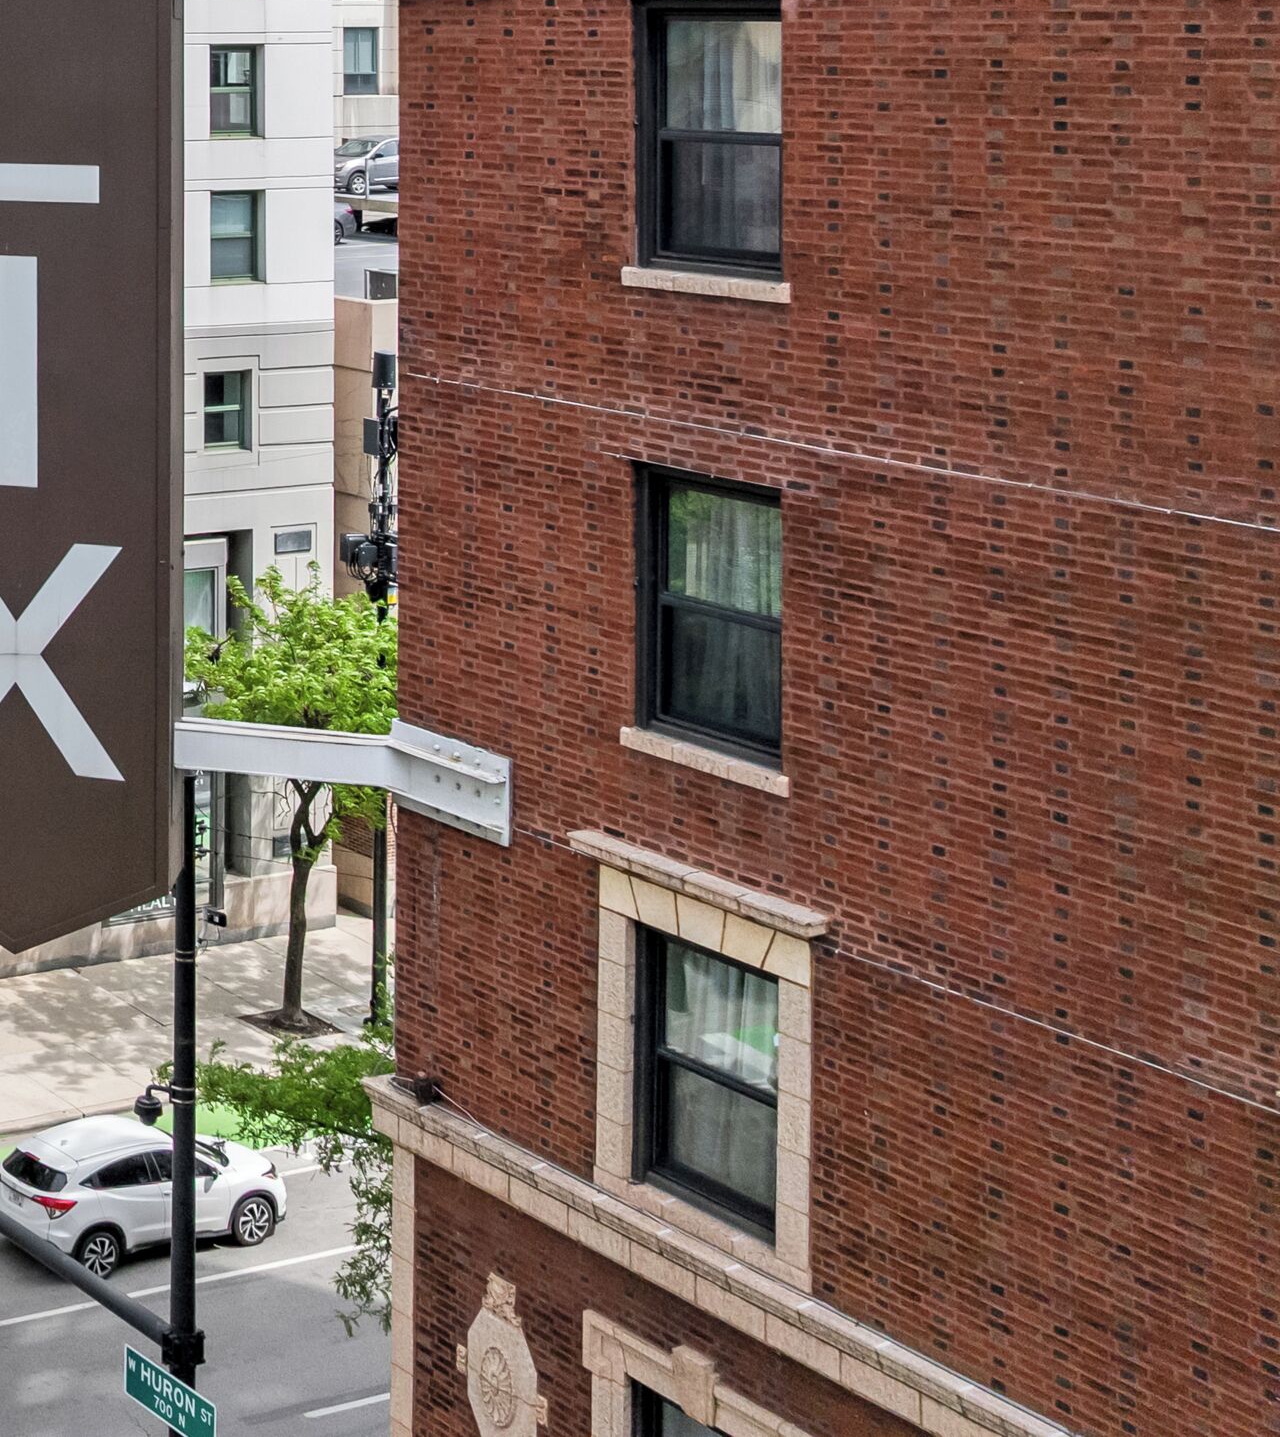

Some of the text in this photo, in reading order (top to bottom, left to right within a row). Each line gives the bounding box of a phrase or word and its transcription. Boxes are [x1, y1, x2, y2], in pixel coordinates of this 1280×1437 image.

[128, 1356, 212, 1426] W HURON ST
[154, 1394, 185, 1429] 700 N
